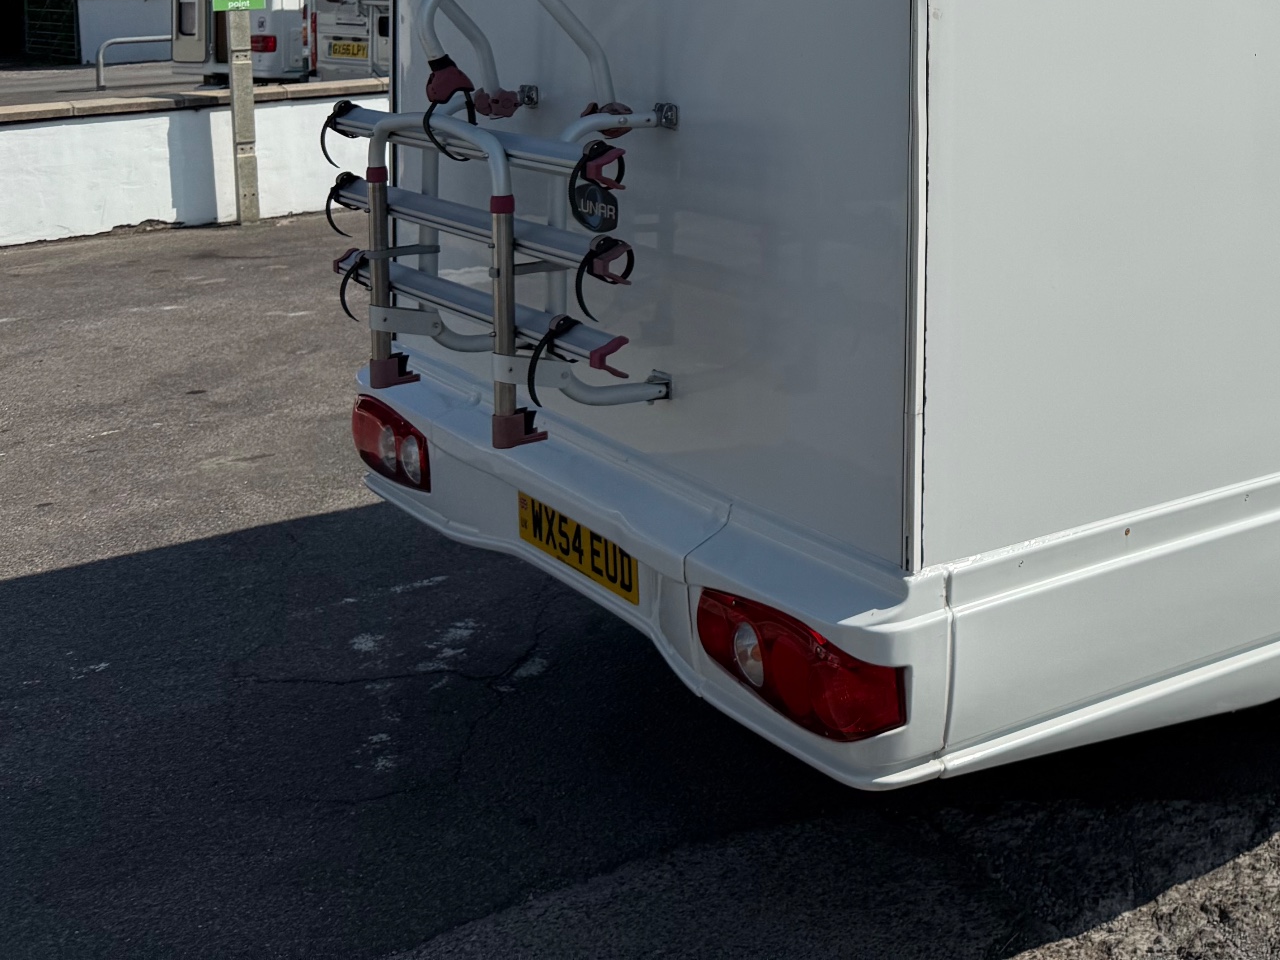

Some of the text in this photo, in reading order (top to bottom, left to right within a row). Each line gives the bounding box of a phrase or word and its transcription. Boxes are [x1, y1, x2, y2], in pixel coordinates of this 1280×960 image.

[228, 0, 250, 9] point
[578, 198, 616, 220] UNAR
[531, 498, 633, 593] WX54 EUD
